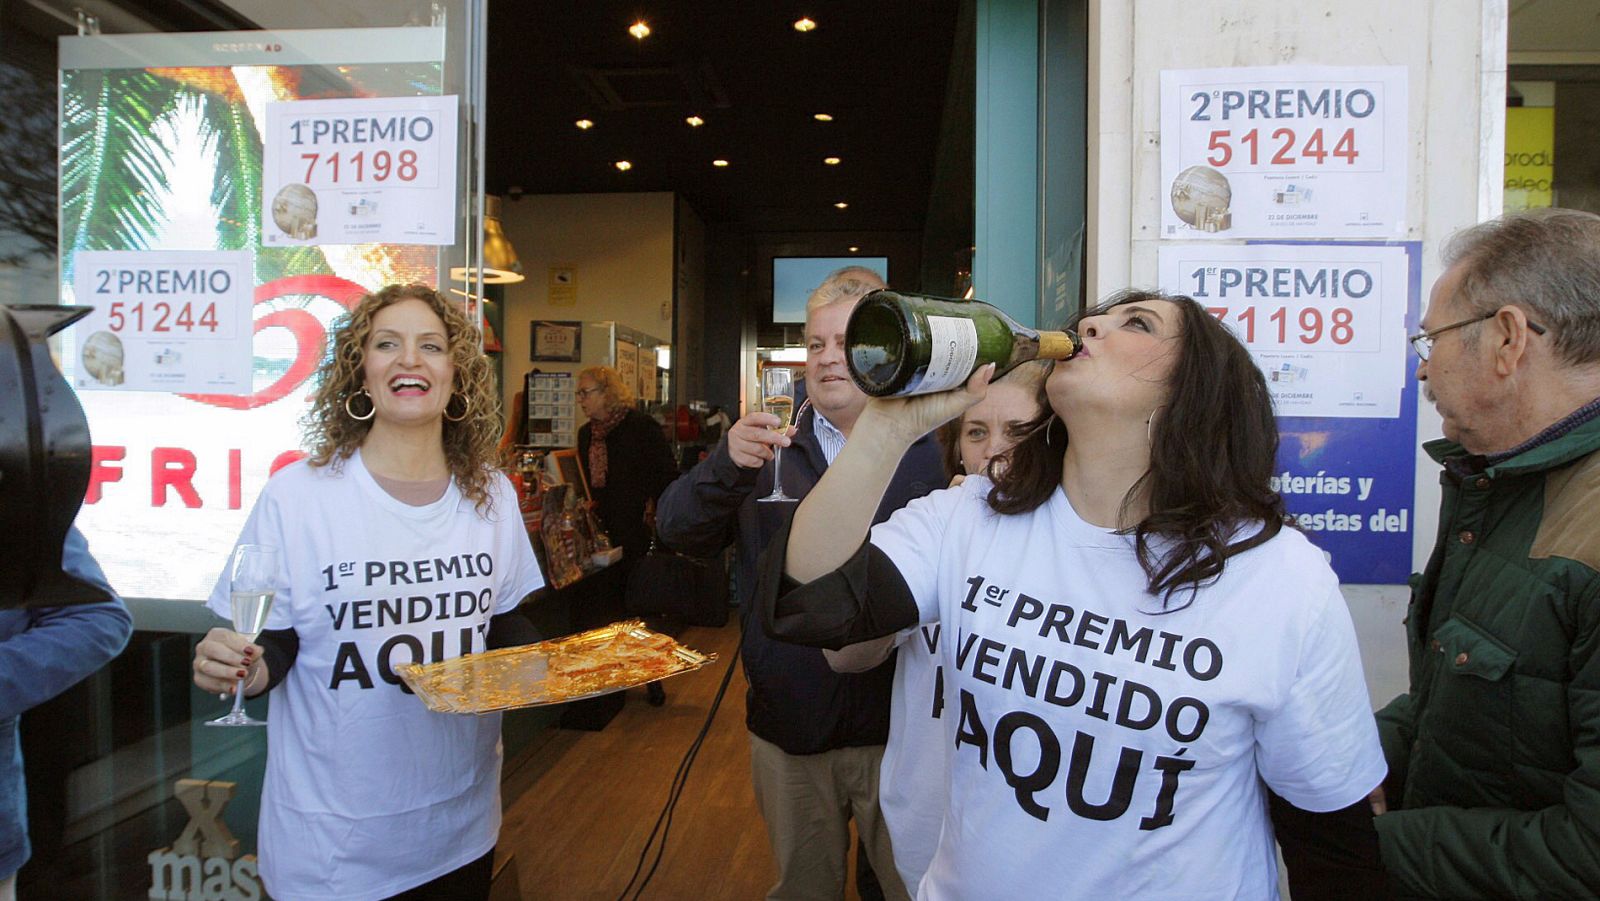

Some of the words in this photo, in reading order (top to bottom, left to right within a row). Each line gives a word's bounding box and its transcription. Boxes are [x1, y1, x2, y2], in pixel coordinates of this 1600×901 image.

[1222, 88, 1376, 120] PREMIO
[312, 116, 434, 145] PREMIO
[1207, 127, 1359, 167] 51244
[301, 149, 418, 184] 71198
[118, 269, 231, 294] PREMIO
[1219, 267, 1373, 299] PREMIO
[109, 301, 219, 332] 51244
[1357, 477, 1374, 501] y
[1369, 507, 1408, 533] del
[365, 552, 493, 587] PREMIO
[325, 587, 493, 631] VENDIDO
[1006, 592, 1224, 682] PREMIO
[955, 626, 1210, 744] VENDIDO
[955, 687, 1196, 831] AQUÍ
[147, 849, 261, 901] mas
